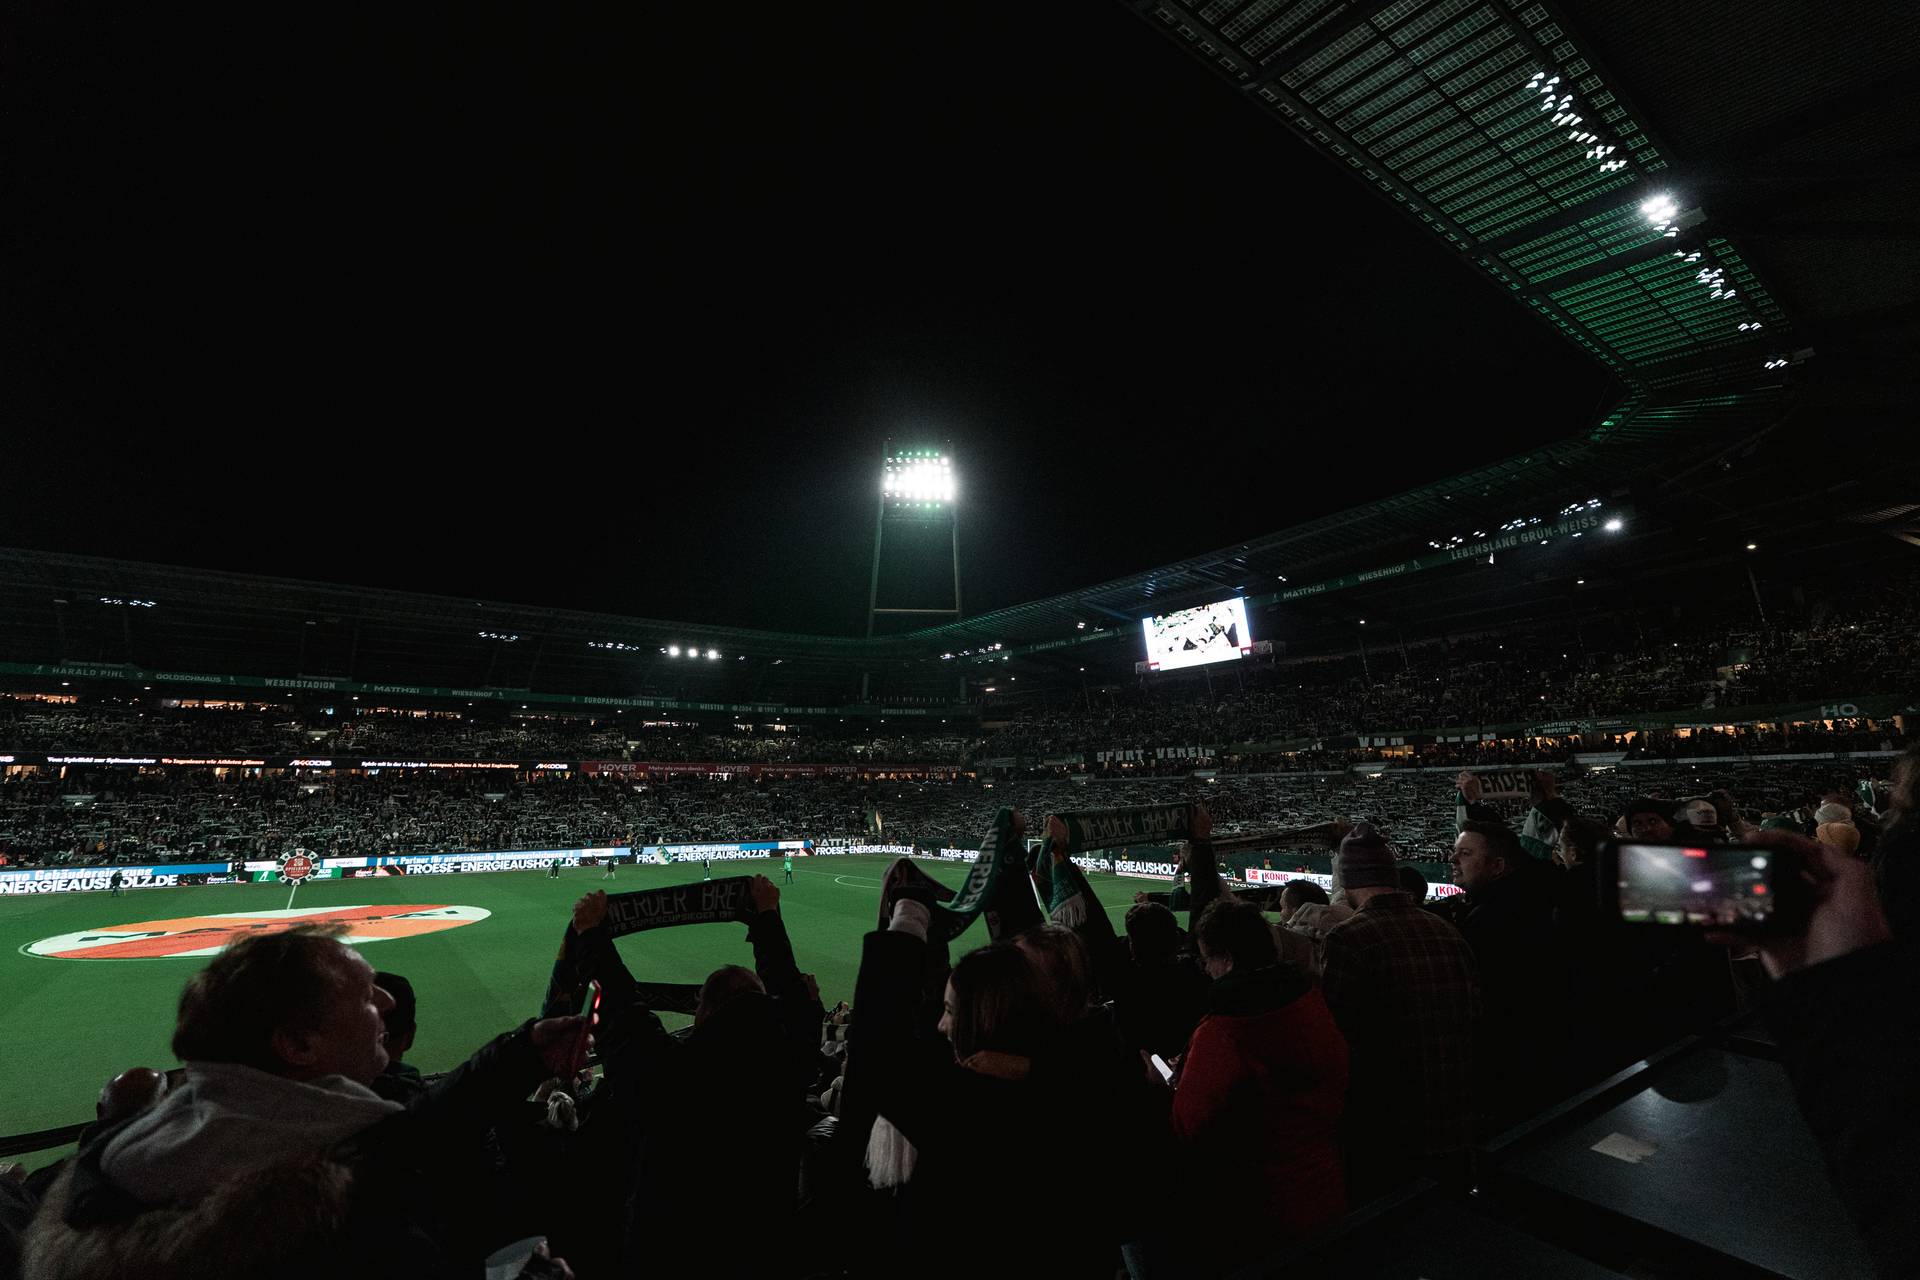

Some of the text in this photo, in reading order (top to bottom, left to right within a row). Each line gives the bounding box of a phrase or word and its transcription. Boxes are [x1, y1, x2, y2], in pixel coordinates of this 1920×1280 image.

[1450, 536, 1518, 561] LEBENSLANG
[1358, 563, 1406, 582] WIESENHOF
[52, 666, 125, 679] HARALD PIHL
[264, 677, 336, 690] WESERSTADION
[598, 763, 637, 772] HOYER
[716, 765, 751, 773] HOYER
[824, 766, 858, 774] HOYER
[400, 856, 429, 865] Partner
[430, 855, 443, 864] für
[636, 849, 771, 865] FRO-ENERGIEAUSHOLZ.DE
[405, 857, 581, 875] FROESE-ENERGIEAUSHO.DE
[608, 889, 688, 923] WERDER
